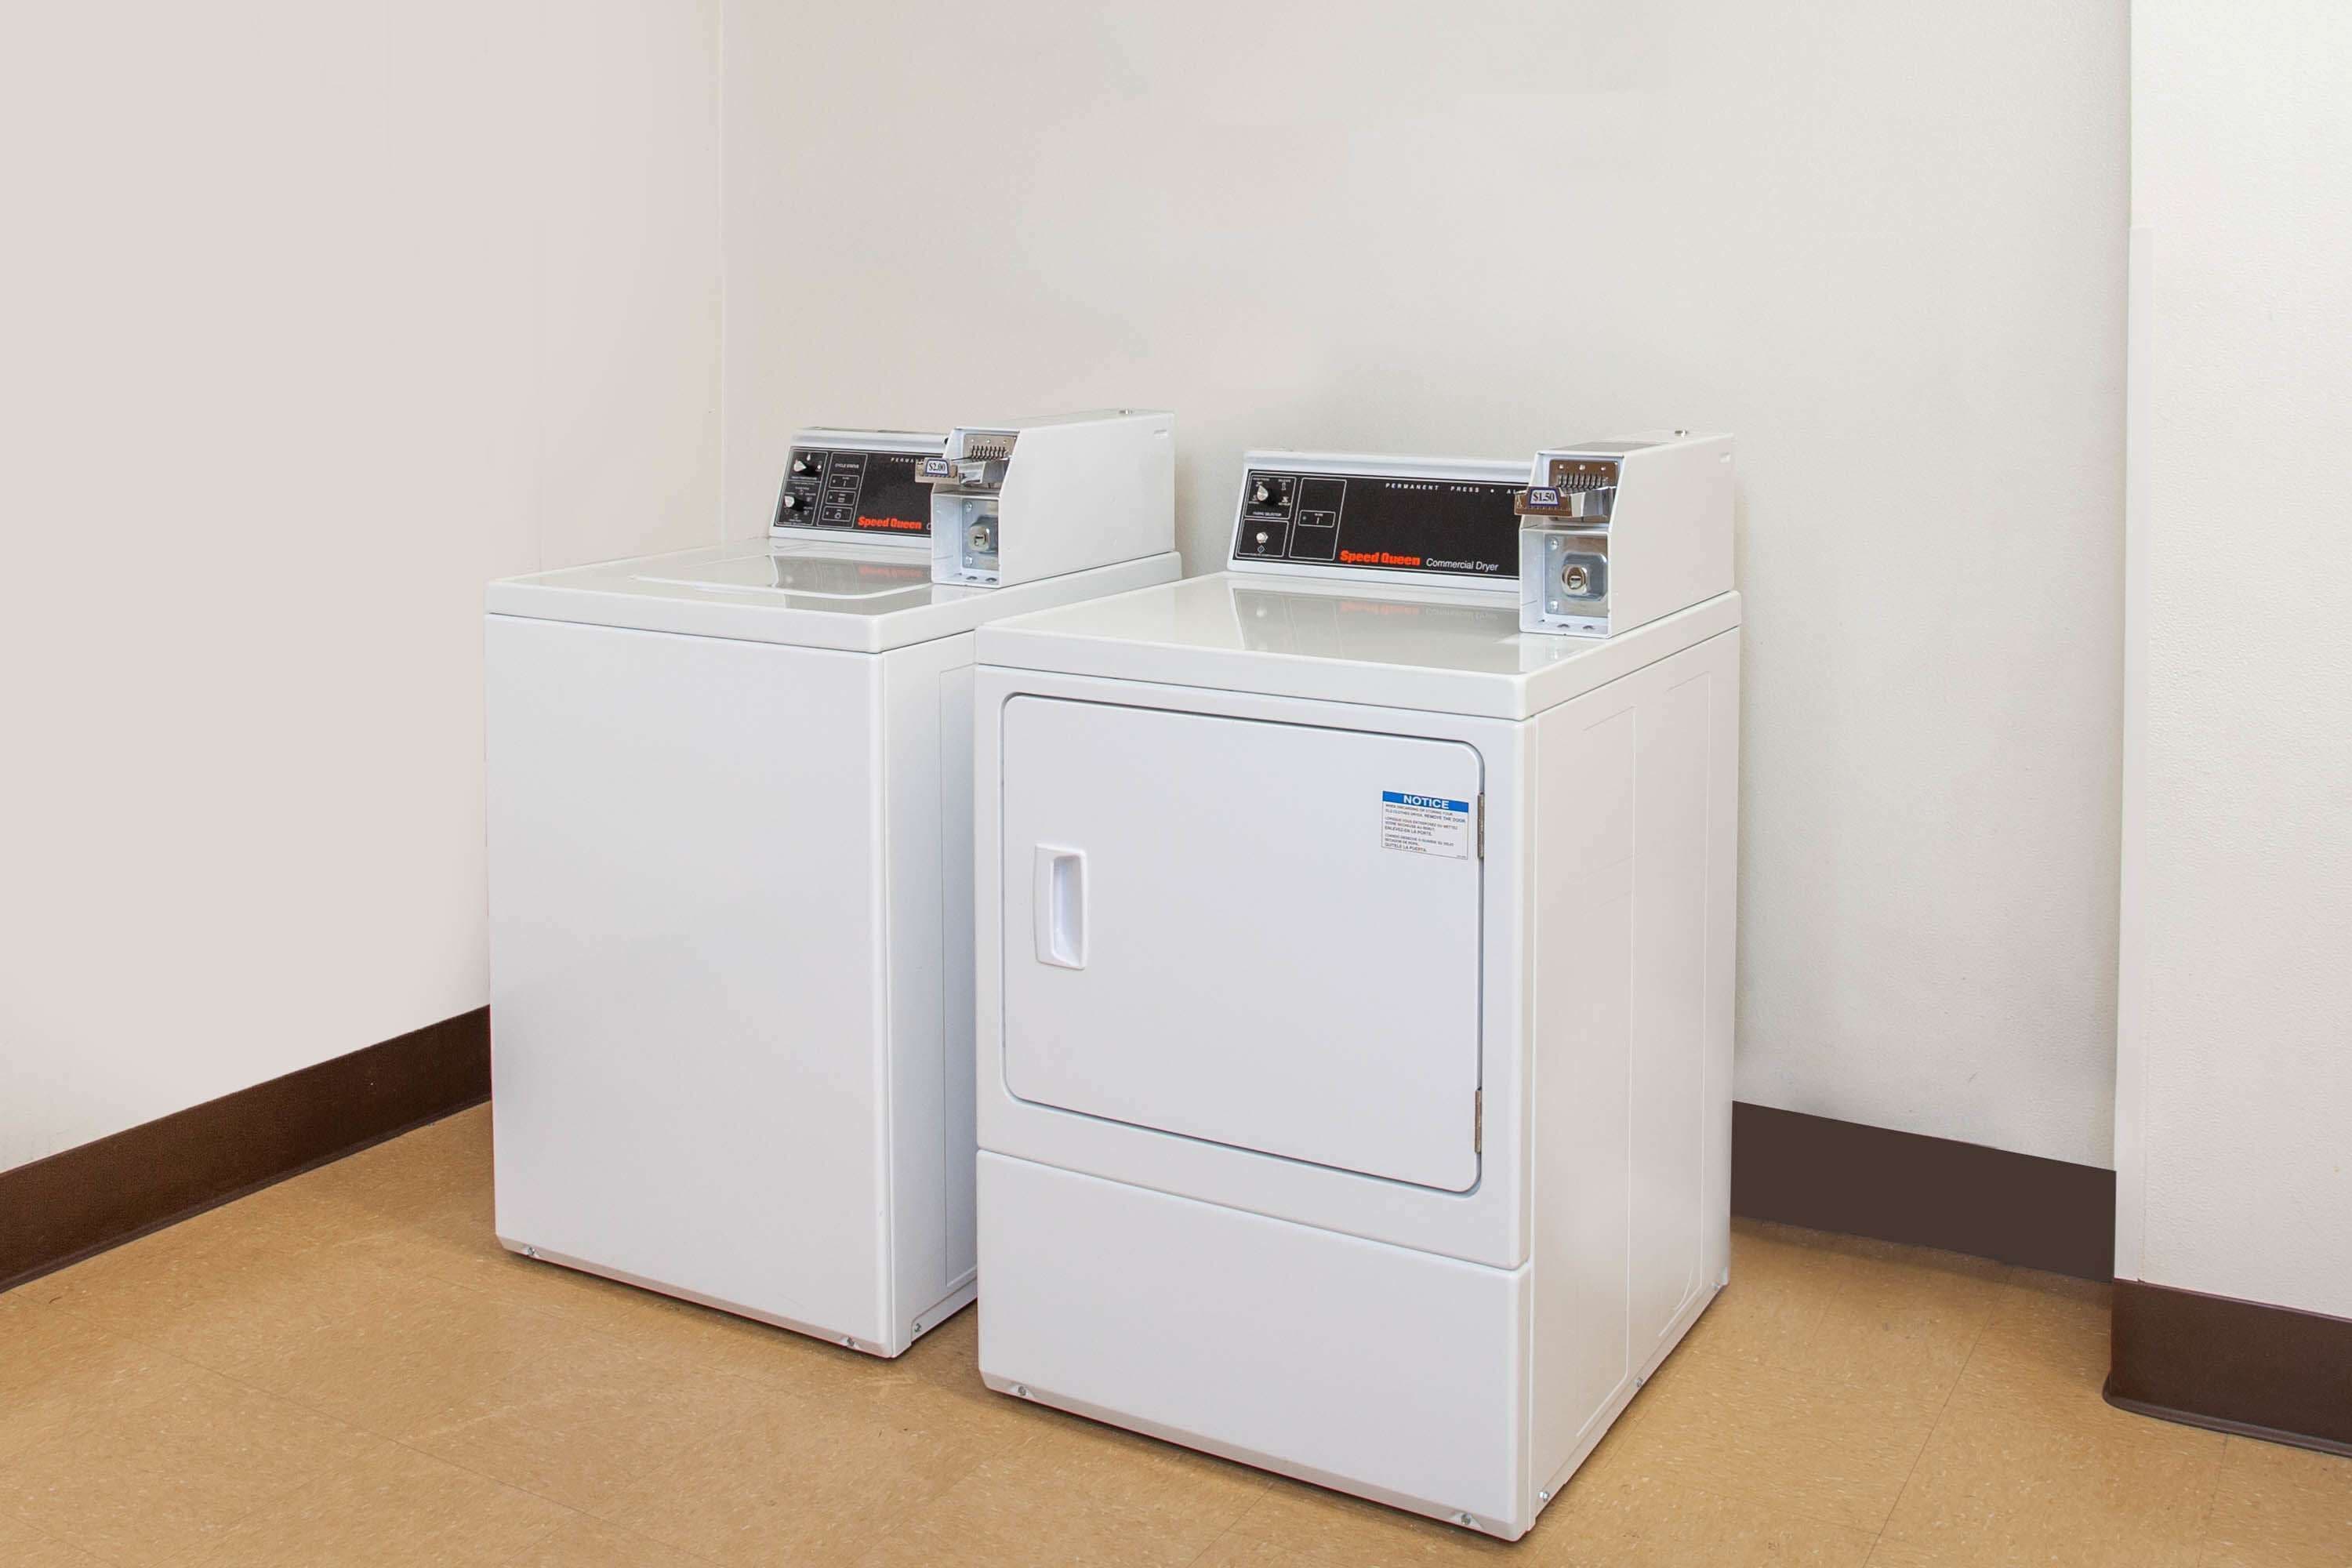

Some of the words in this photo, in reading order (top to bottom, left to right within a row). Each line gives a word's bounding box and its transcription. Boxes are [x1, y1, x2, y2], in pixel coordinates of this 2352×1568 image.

[928, 463, 946, 471] $2.00
[1533, 492, 1555, 502] $1.50
[858, 516, 889, 528] Speed
[890, 517, 922, 530] Queen
[1340, 550, 1380, 563] Speed
[1381, 552, 1421, 566] Queen
[1426, 558, 1474, 570] Commercial
[1475, 561, 1499, 572] Dryer
[1403, 795, 1450, 809] NOTICE
